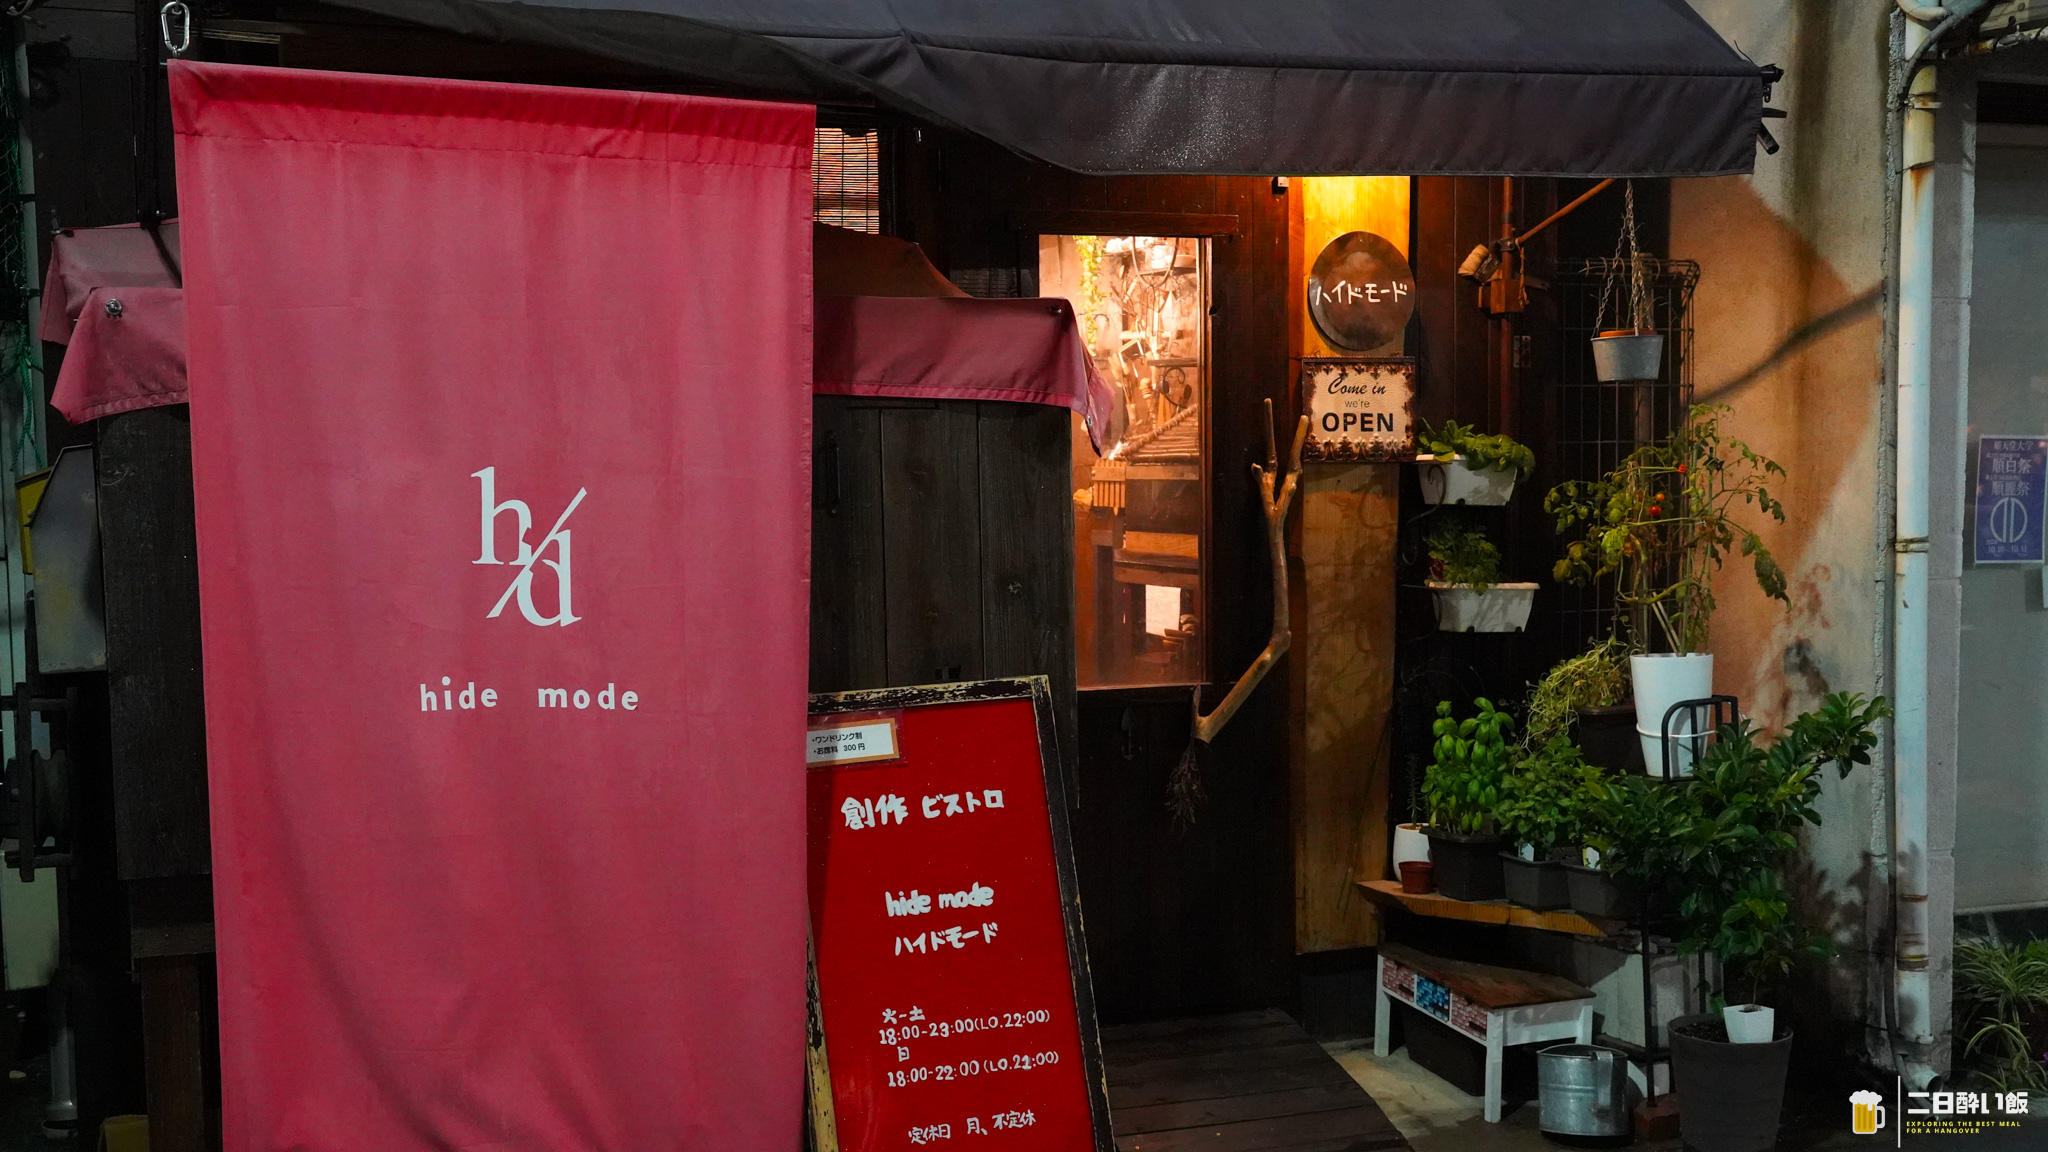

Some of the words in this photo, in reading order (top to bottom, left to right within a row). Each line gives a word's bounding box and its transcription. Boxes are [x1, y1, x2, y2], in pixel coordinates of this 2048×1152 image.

[1315, 280, 1408, 306] ハイドモード
[1327, 377, 1367, 395] Come
[1372, 381, 1386, 395] in
[1344, 399, 1370, 408] we're
[1322, 412, 1394, 432] OPEN
[420, 676, 498, 711] hide
[538, 683, 639, 710] mode
[840, 793, 909, 830] 創作
[921, 789, 1004, 819] ビストロ
[885, 889, 931, 917] hide
[938, 881, 995, 909] mode
[895, 922, 998, 956] ハイドモード
[897, 1046, 910, 1062] 日
[908, 1123, 951, 1145] 定休日
